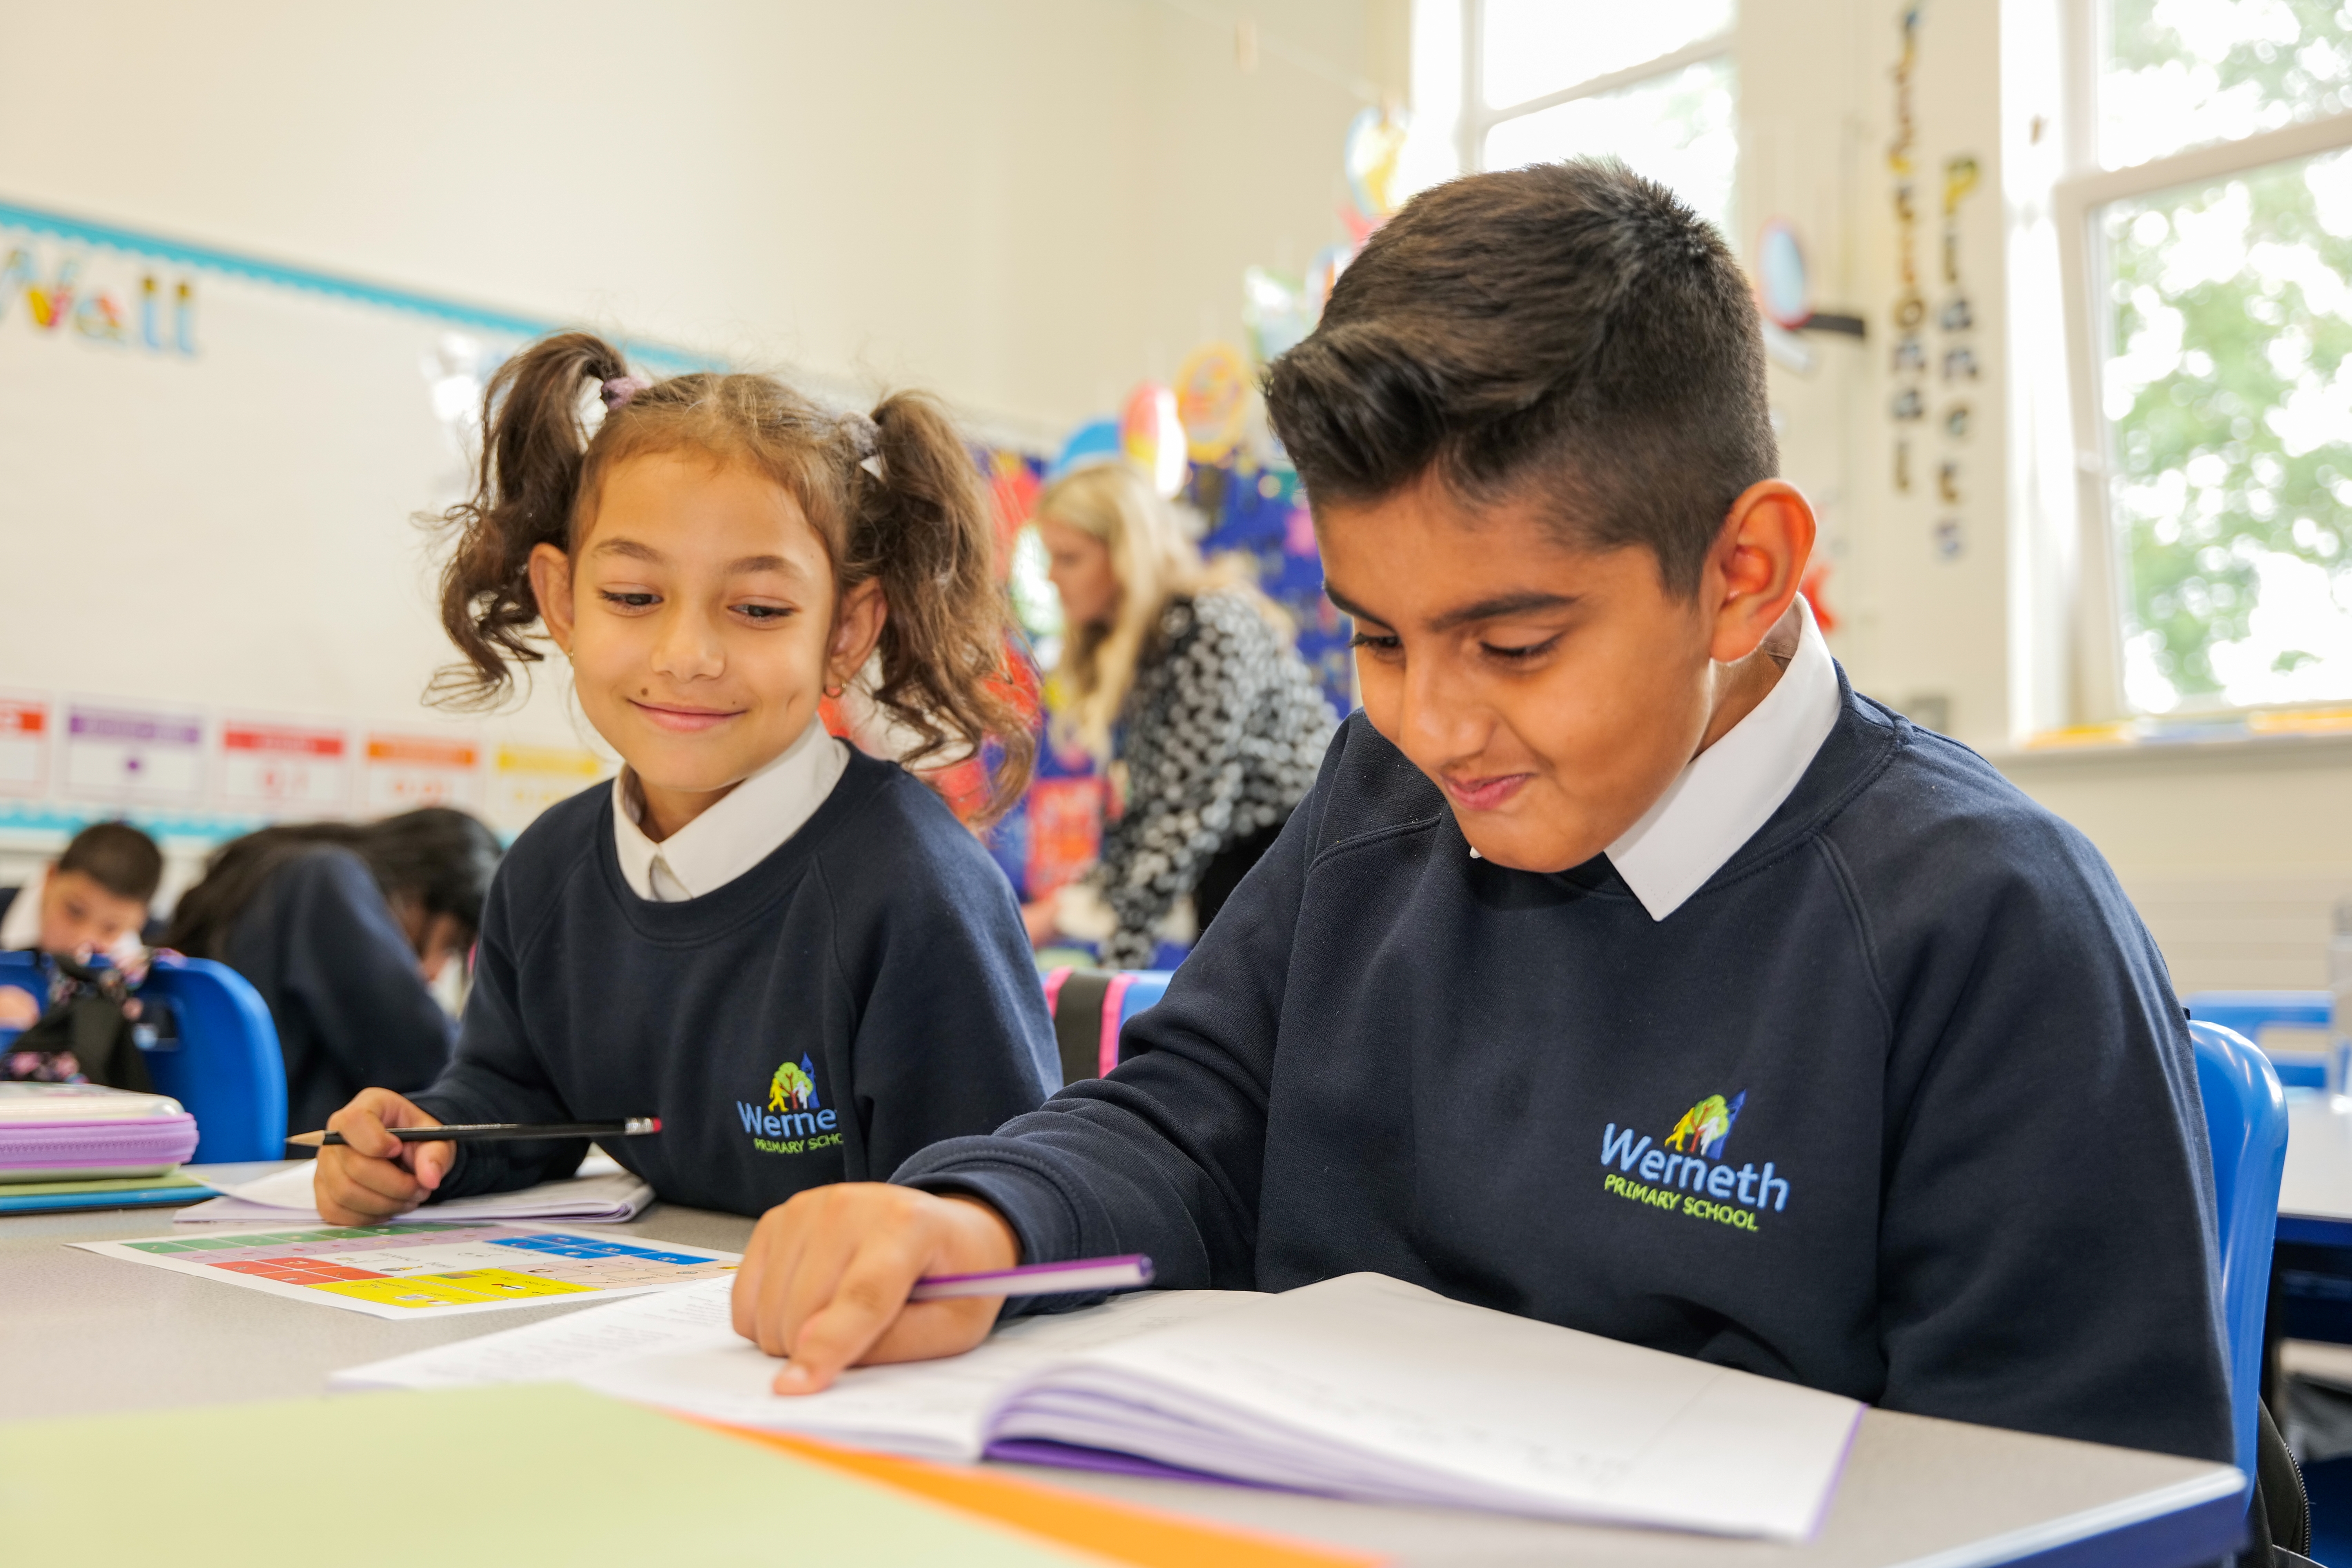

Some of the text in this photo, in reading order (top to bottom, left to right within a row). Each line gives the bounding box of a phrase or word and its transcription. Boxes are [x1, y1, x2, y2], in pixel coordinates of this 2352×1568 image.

[736, 1100, 837, 1138] Werne
[753, 1138, 805, 1154] PRIMARY
[1601, 1123, 1790, 1212] Werneth
[1604, 1173, 1759, 1232] PRIMARY SCHOOL
